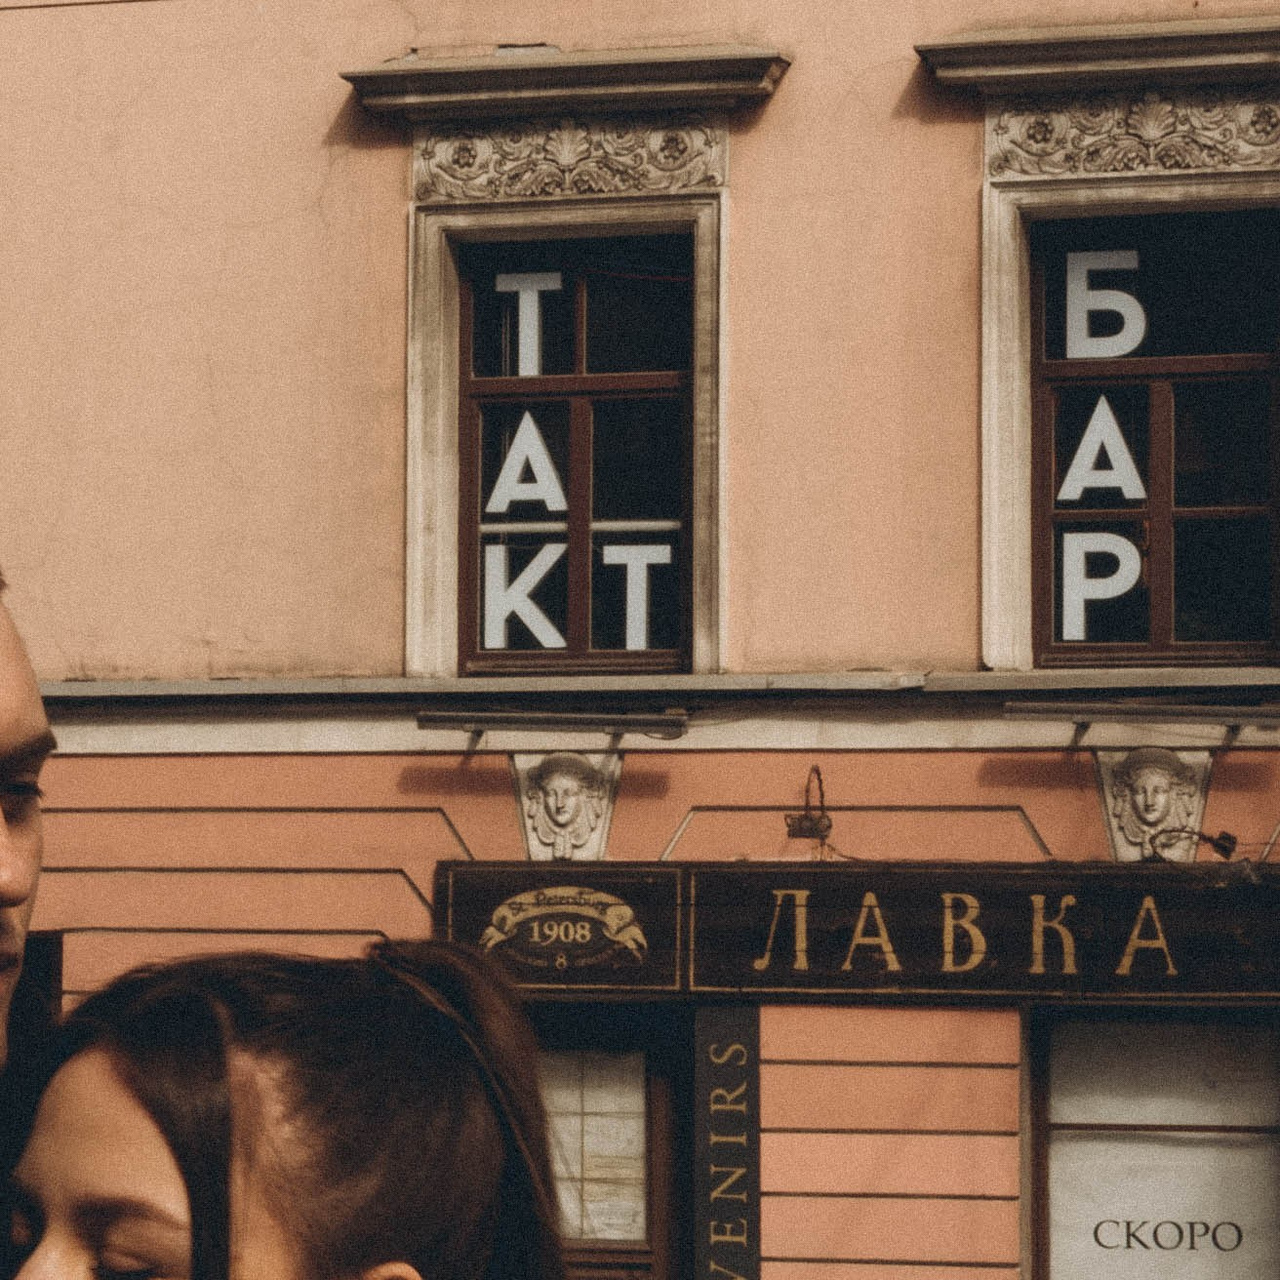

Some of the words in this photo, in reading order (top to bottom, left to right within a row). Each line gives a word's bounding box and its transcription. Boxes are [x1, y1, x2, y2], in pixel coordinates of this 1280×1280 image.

[1056, 250, 1147, 642] БАР
[528, 921, 593, 946] 1908
[753, 889, 1179, 975] ЛАВКА
[1093, 1219, 1244, 1253] СКОРО
